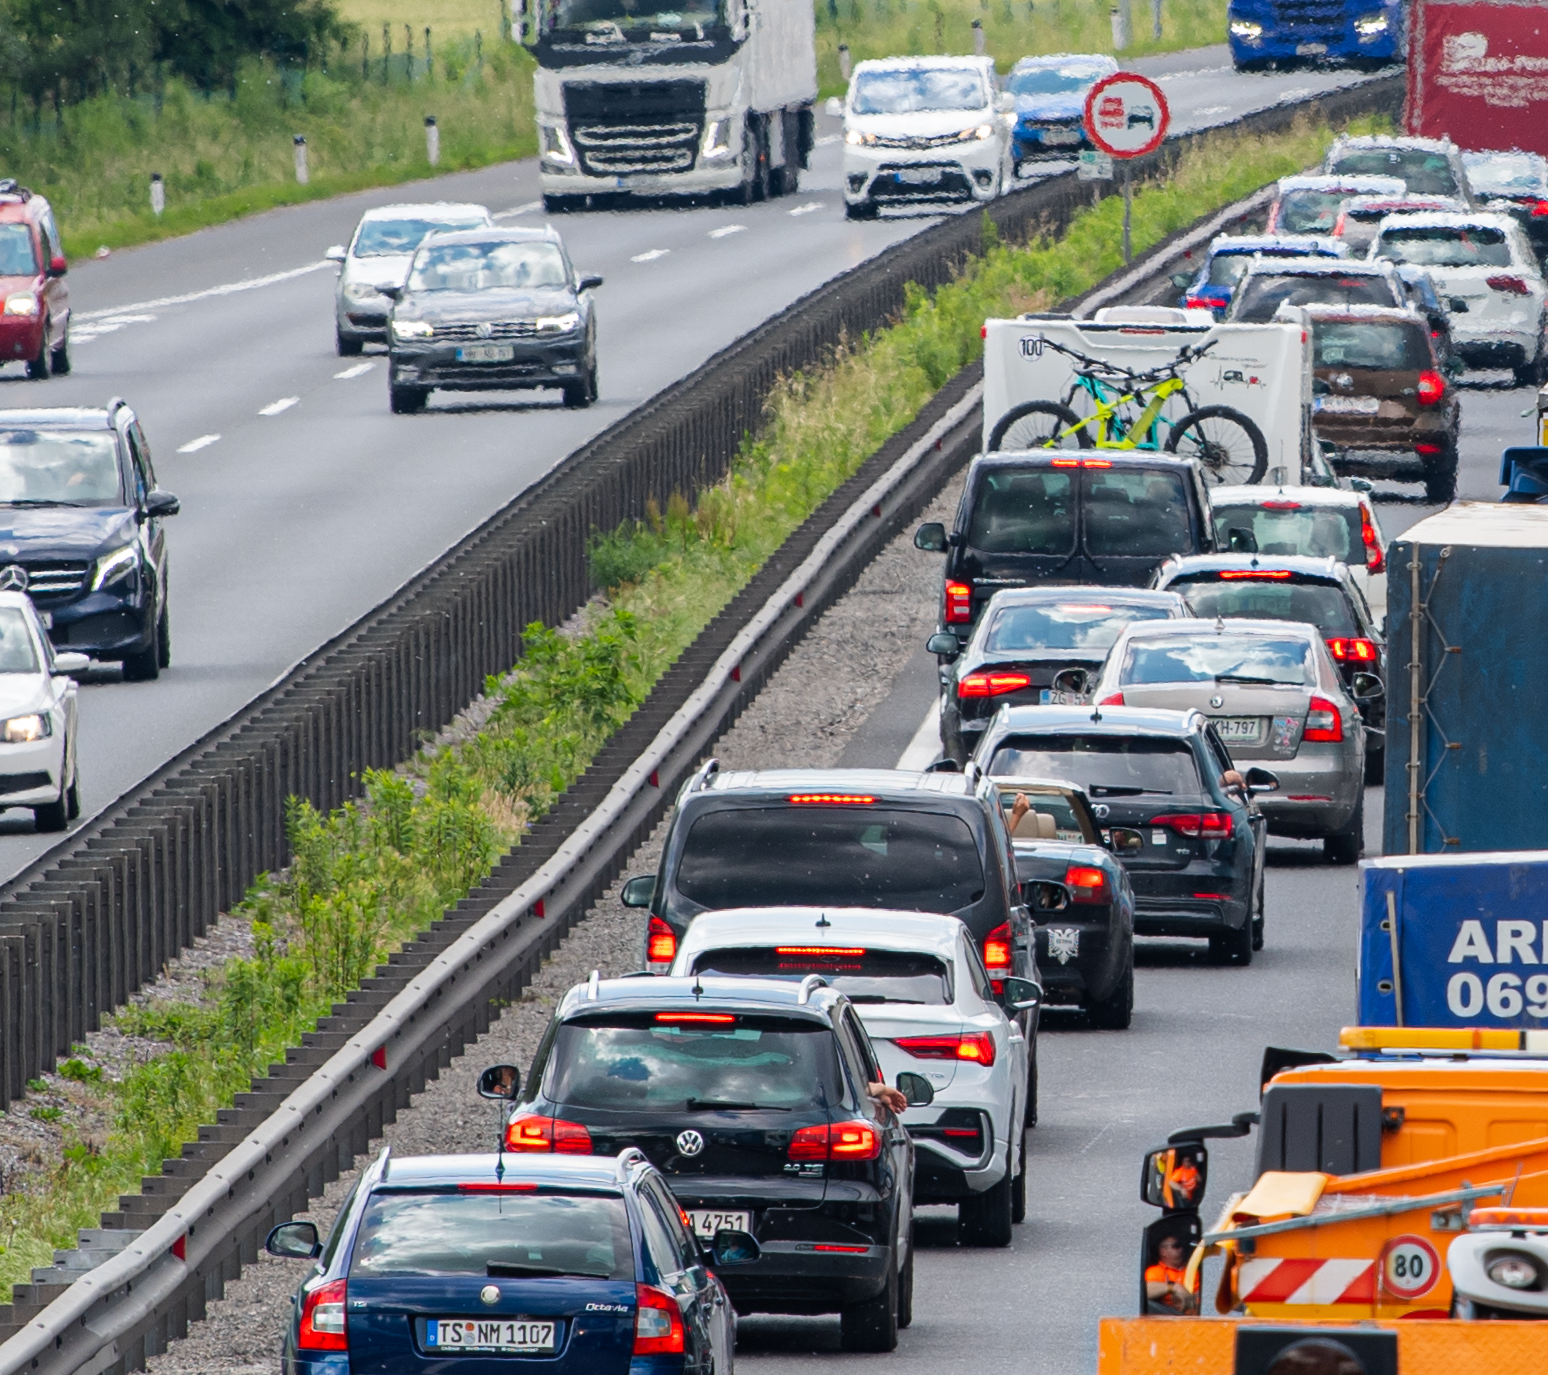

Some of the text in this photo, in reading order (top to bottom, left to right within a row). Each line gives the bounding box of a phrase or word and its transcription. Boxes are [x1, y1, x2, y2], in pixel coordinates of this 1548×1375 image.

[1021, 338, 1043, 356] 100
[1394, 1254, 1424, 1278] 80
[585, 1302, 629, 1313] Octavia
[439, 1322, 463, 1342] TS
[477, 1323, 500, 1343] NM
[506, 1324, 552, 1344] 1107
